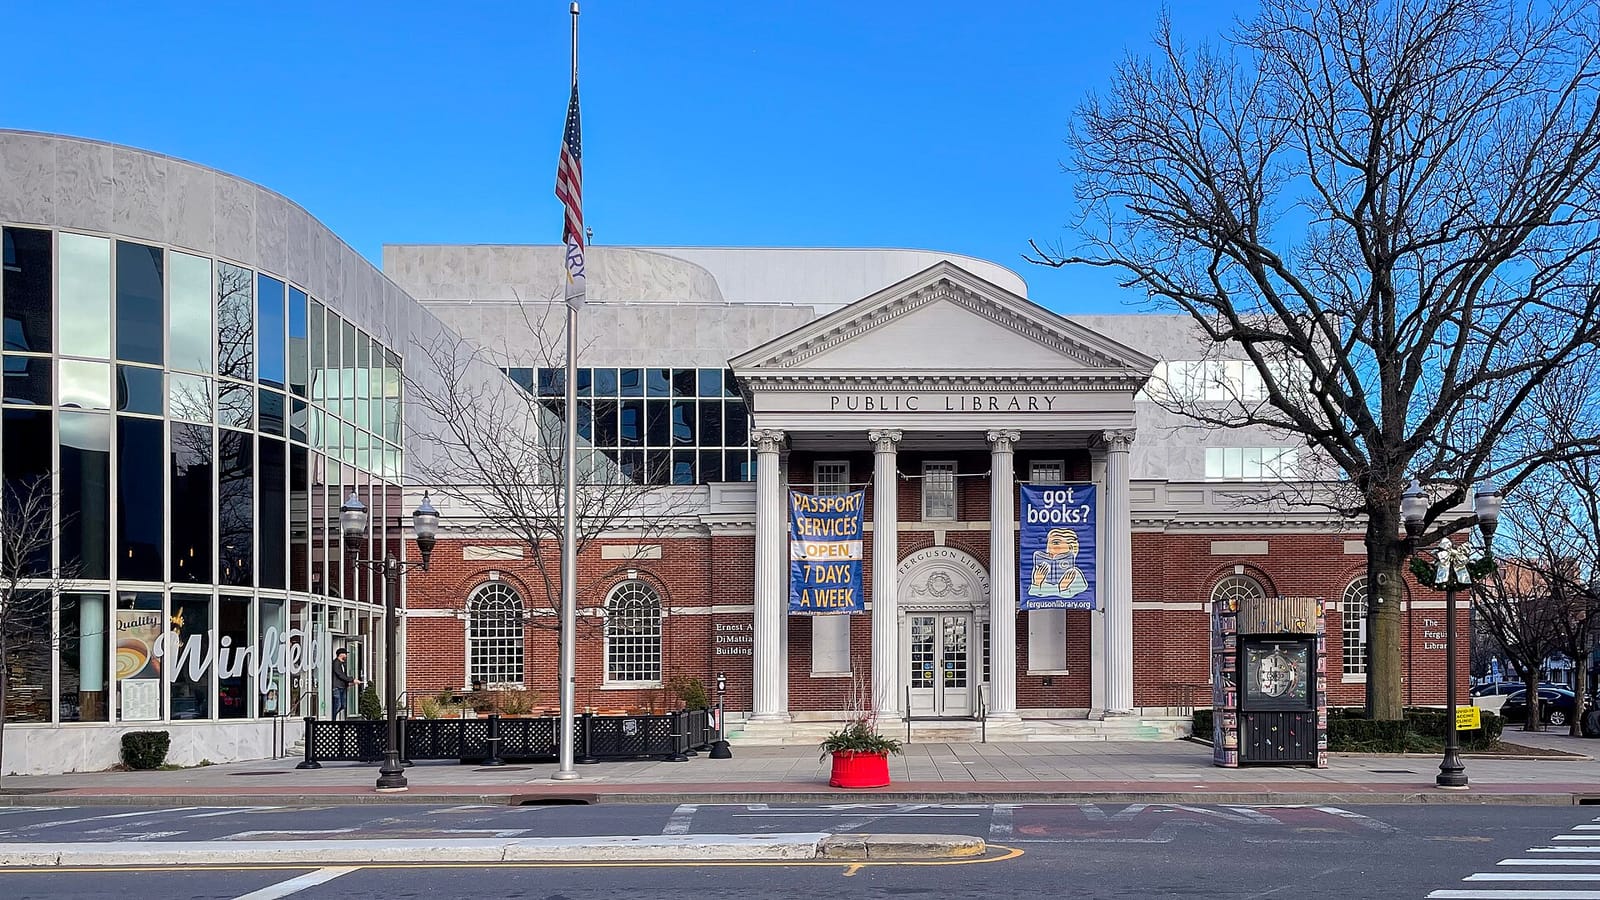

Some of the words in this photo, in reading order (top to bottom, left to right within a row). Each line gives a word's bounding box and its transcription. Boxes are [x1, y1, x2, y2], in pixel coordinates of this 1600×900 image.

[831, 396, 919, 411] PUBLIC
[945, 396, 1057, 411] LIBRARY
[793, 492, 862, 513] PASSPORT
[1043, 487, 1075, 508] got
[1027, 504, 1090, 523] books?
[796, 515, 858, 536] SERVICES
[806, 544, 849, 557] OPEN
[899, 549, 957, 575] FERGUSON
[803, 565, 811, 584] 7
[815, 564, 851, 584] DAYS
[800, 588, 811, 607] A
[814, 588, 854, 608] WEEK
[1026, 600, 1091, 609] fergusonlibrary.org
[116, 615, 162, 632] Quality
[716, 623, 743, 631] Ernest
[1423, 618, 1438, 627] The
[716, 635, 753, 643] DiMattia
[1424, 642, 1448, 650] Librar
[153, 622, 323, 695] Winfield
[716, 646, 753, 656] Building
